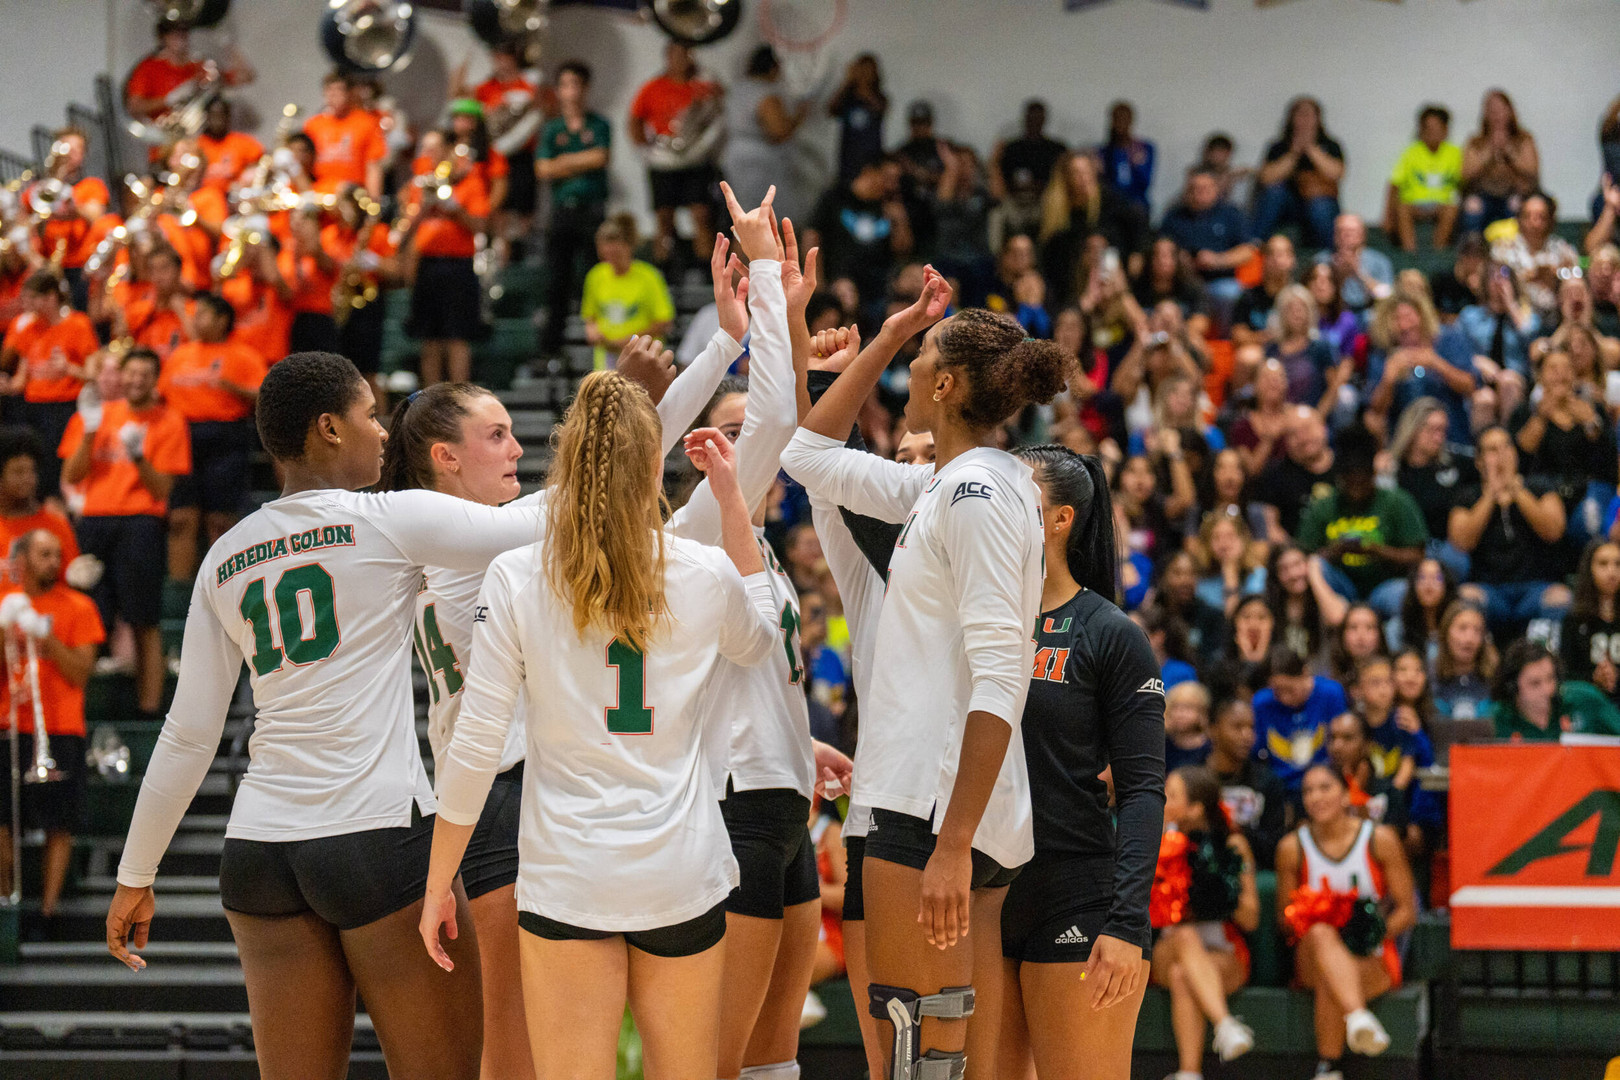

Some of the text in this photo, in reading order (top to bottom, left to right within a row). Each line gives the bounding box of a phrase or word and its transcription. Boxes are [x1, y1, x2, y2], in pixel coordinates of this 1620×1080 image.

[952, 481, 994, 501] ACC
[216, 524, 356, 588] HEREDIA COLON
[239, 562, 341, 677] 10
[1042, 617, 1073, 634] U
[414, 602, 465, 706] 14
[604, 626, 655, 735] 1
[1055, 936, 1089, 944] adidas
